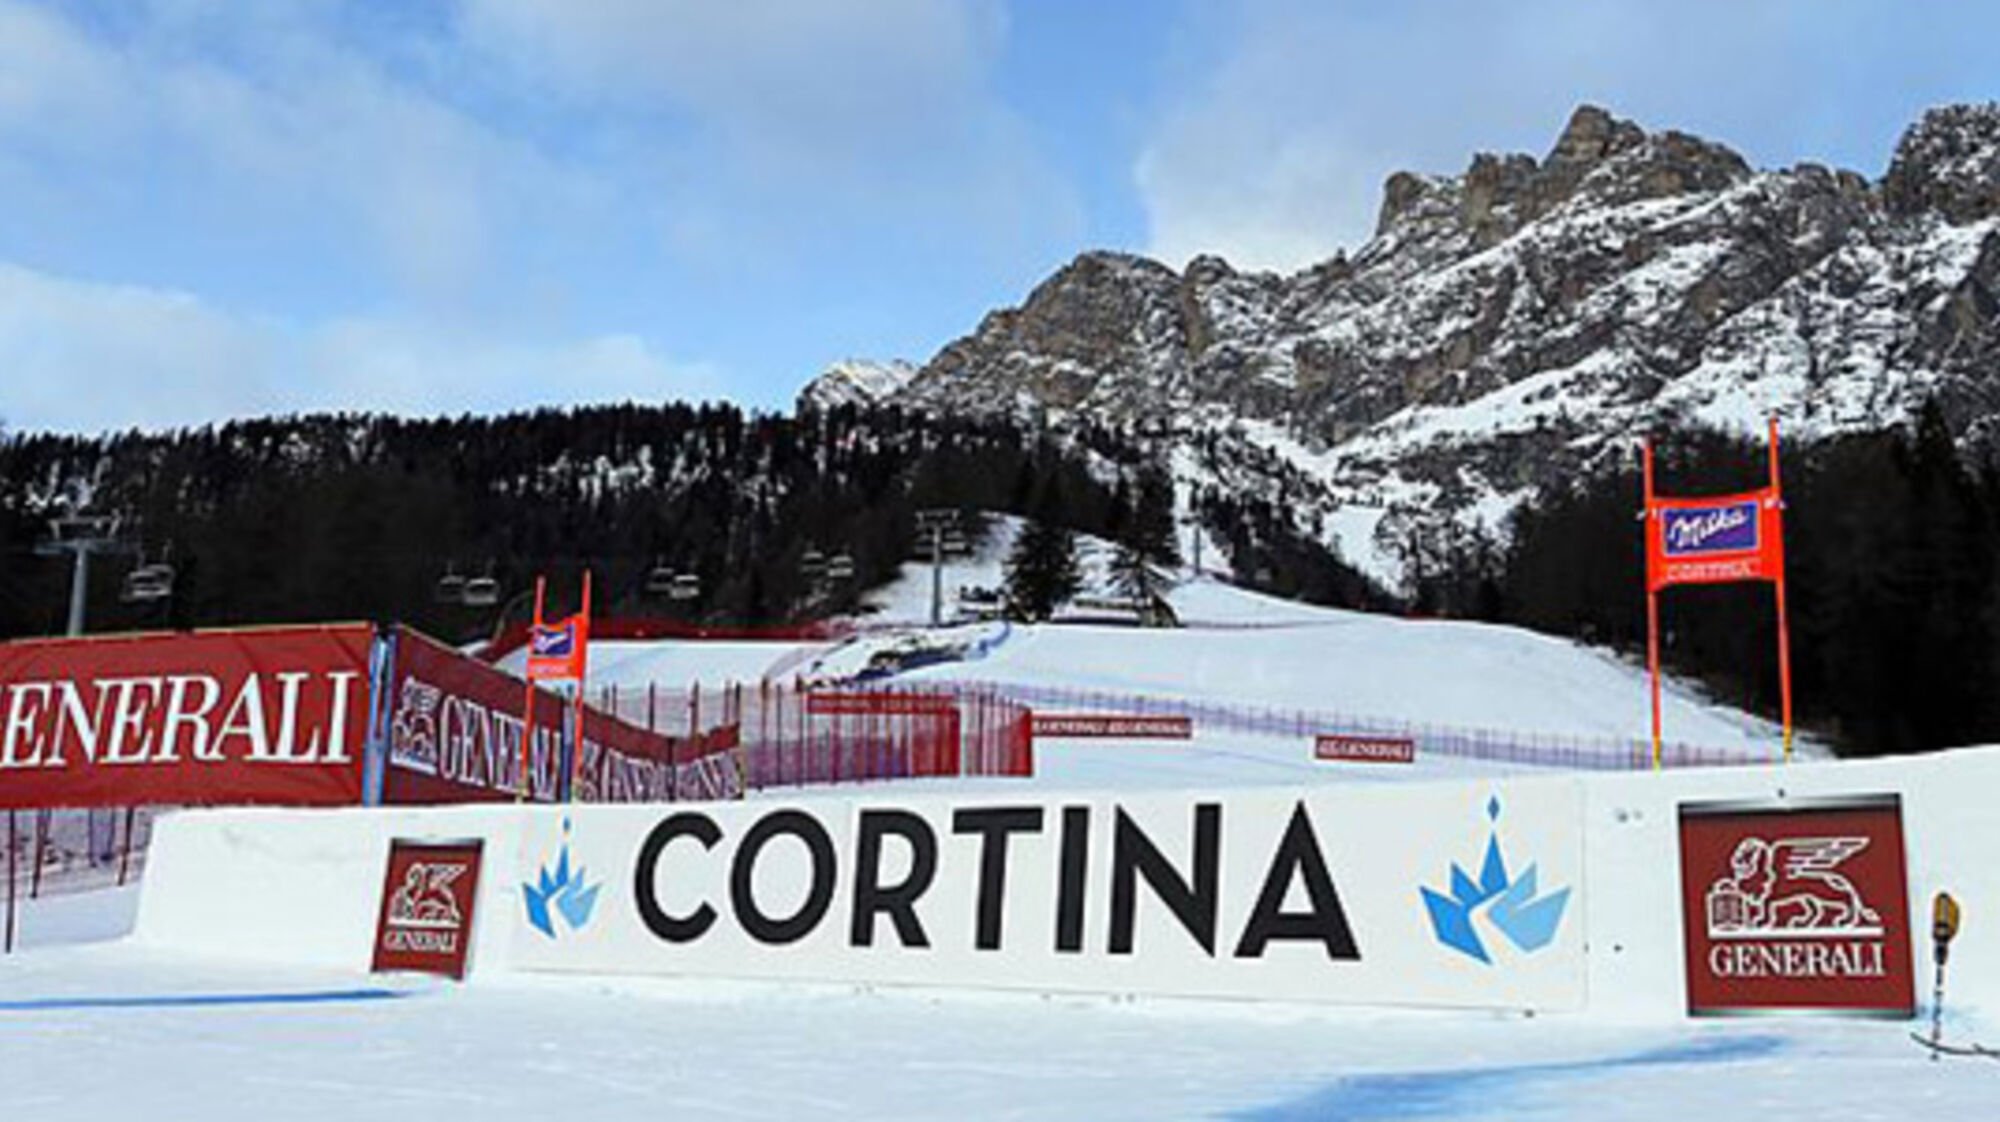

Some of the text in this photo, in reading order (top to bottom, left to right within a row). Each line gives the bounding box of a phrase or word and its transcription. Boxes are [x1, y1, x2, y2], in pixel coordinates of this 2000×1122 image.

[1668, 508, 1748, 548] Milka
[0, 672, 358, 768] ENERALI
[634, 800, 1362, 961] CORTINA
[384, 930, 456, 953] GENERALI
[1708, 942, 1885, 977] GENERALI
